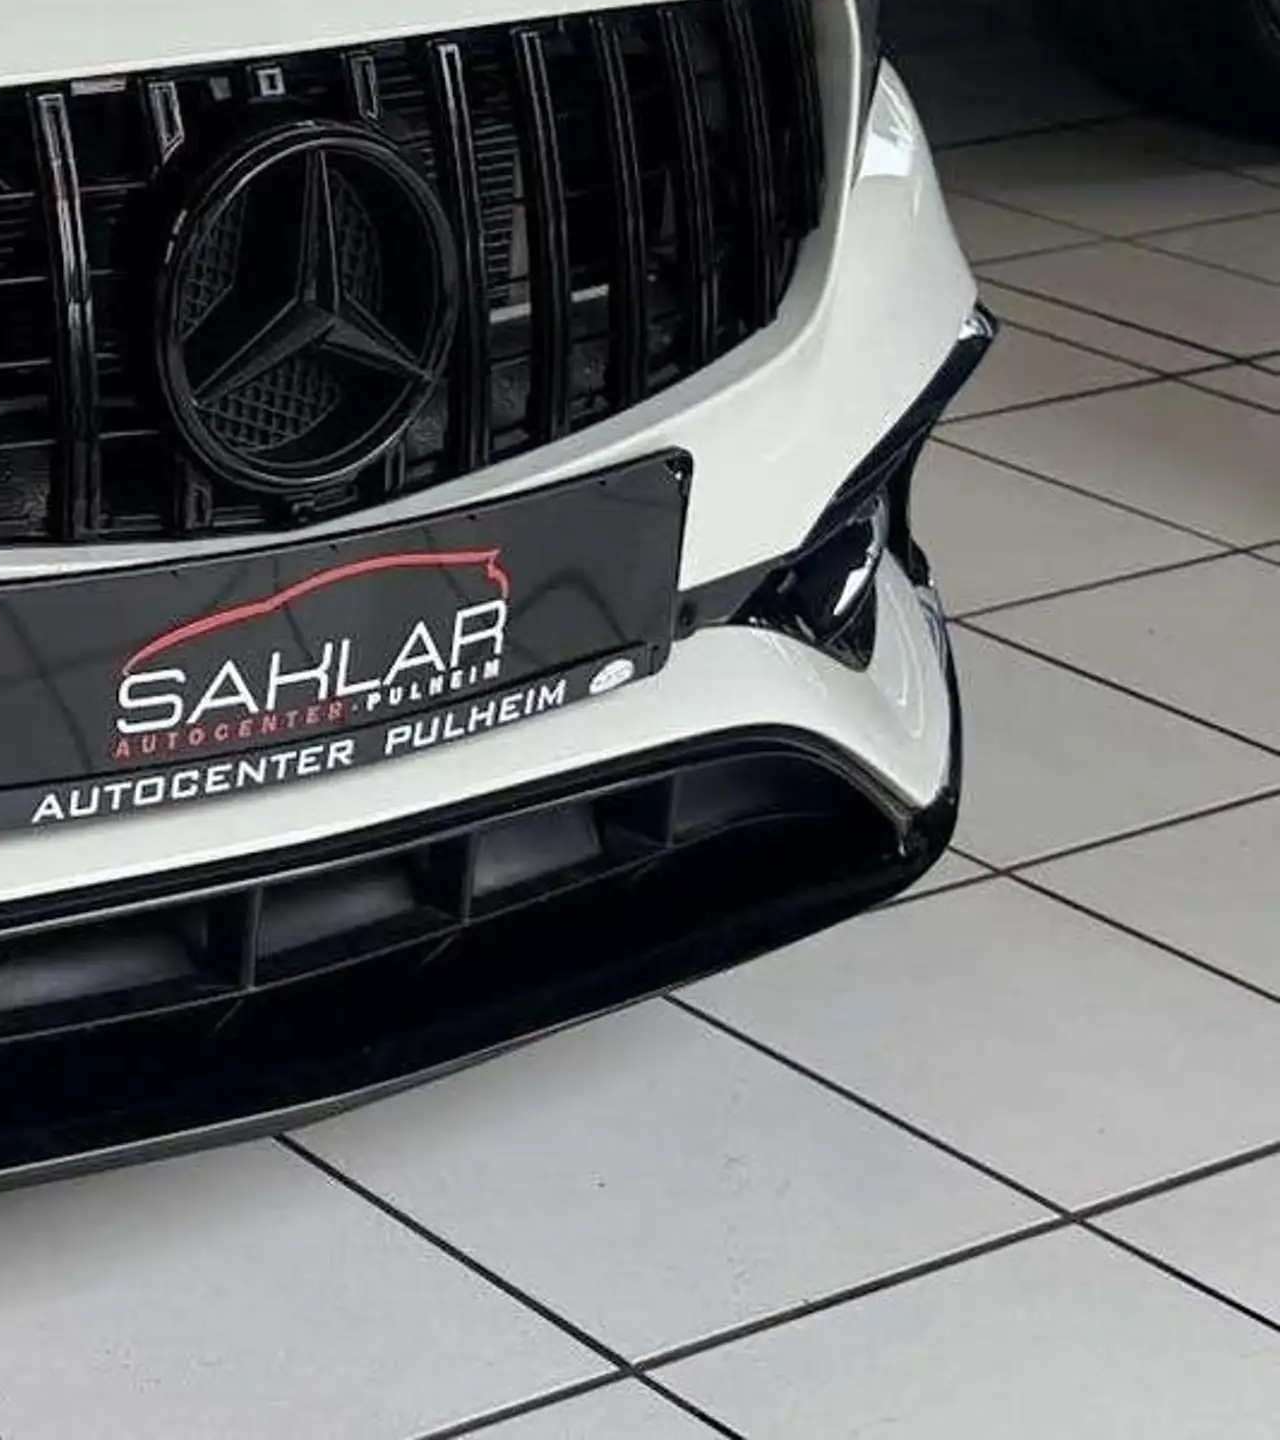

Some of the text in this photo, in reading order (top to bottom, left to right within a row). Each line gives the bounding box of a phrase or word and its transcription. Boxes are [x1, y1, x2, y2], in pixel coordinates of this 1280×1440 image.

[112, 699, 346, 761] AUTOCENTER
[115, 599, 509, 735] SAHLAR
[31, 678, 568, 824] AUTOCENTER PULHEIM
